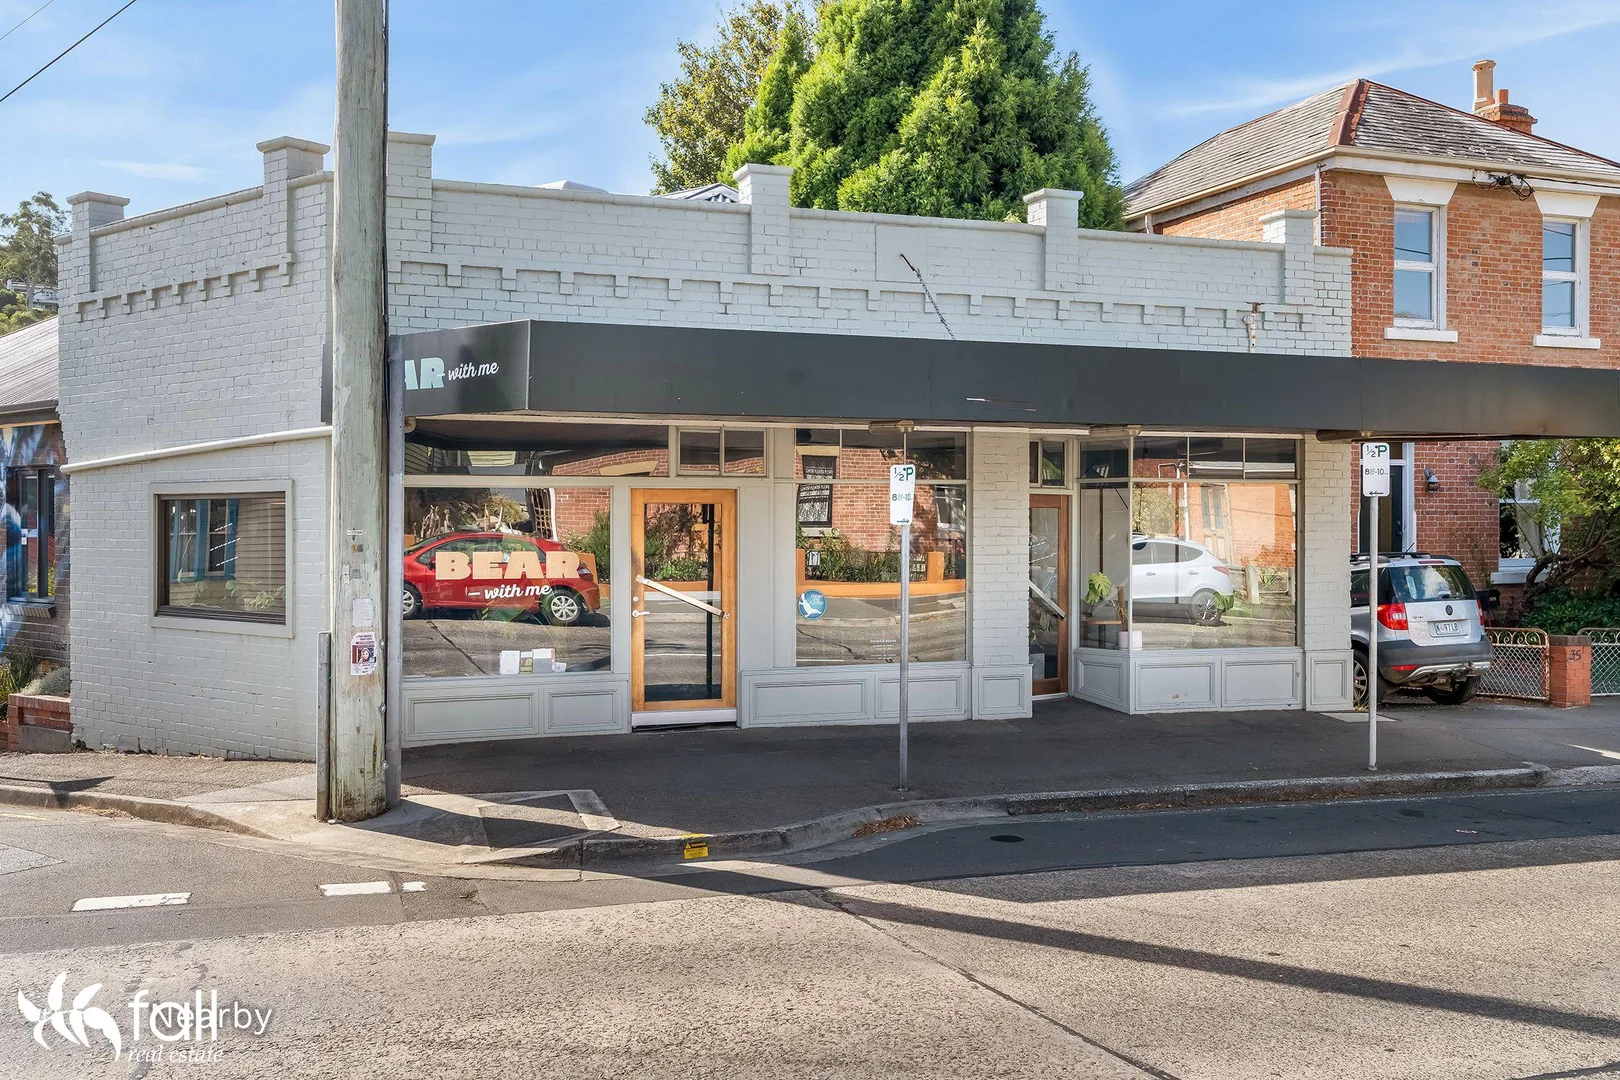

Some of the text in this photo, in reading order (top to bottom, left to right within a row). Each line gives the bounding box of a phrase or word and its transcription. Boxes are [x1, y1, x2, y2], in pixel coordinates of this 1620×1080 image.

[448, 362, 478, 381] with
[478, 362, 499, 376] me
[435, 551, 580, 580] BEAR
[484, 584, 552, 599] with me
